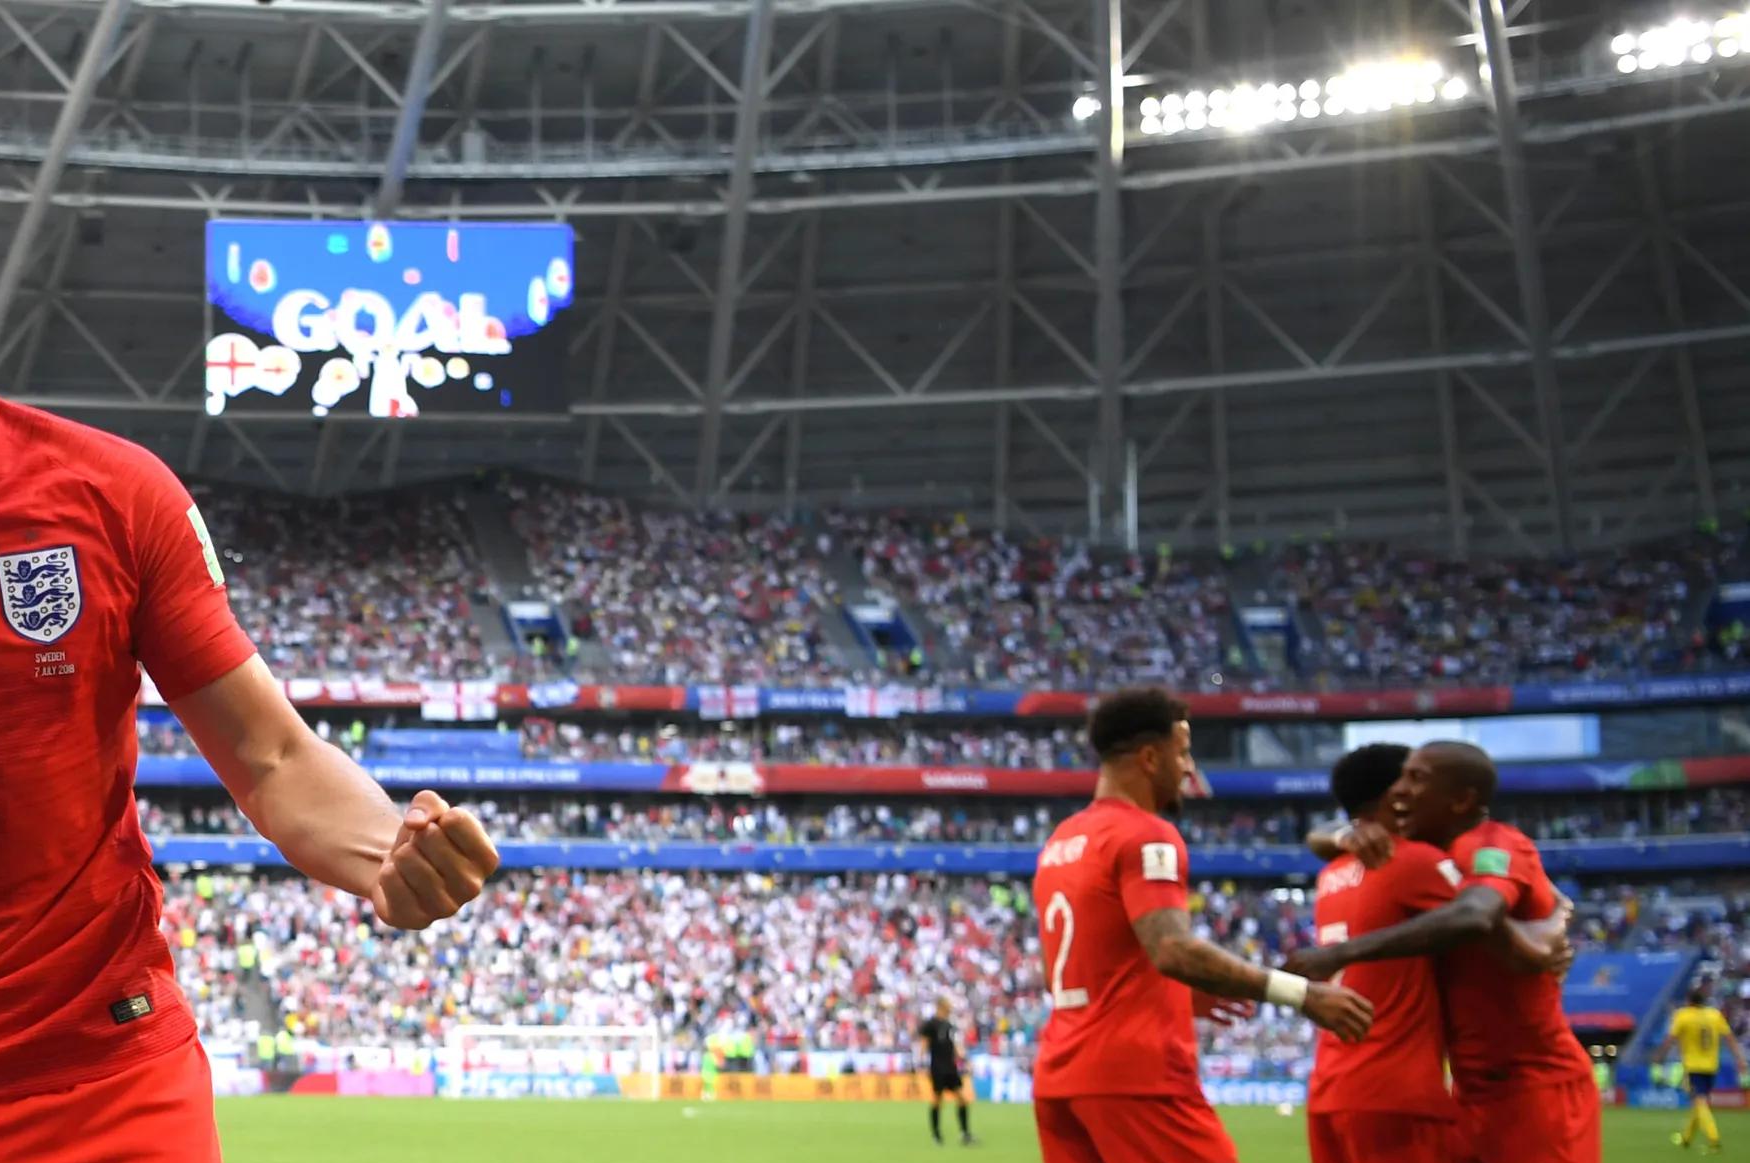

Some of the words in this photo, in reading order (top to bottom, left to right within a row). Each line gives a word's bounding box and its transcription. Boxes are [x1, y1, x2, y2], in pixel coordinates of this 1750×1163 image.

[272, 289, 512, 354] GOAL
[34, 667, 40, 678] 7
[41, 665, 57, 677] JULY
[58, 663, 75, 675] 2018
[35, 651, 66, 663] SWEDEN
[1045, 891, 1090, 1009] 2
